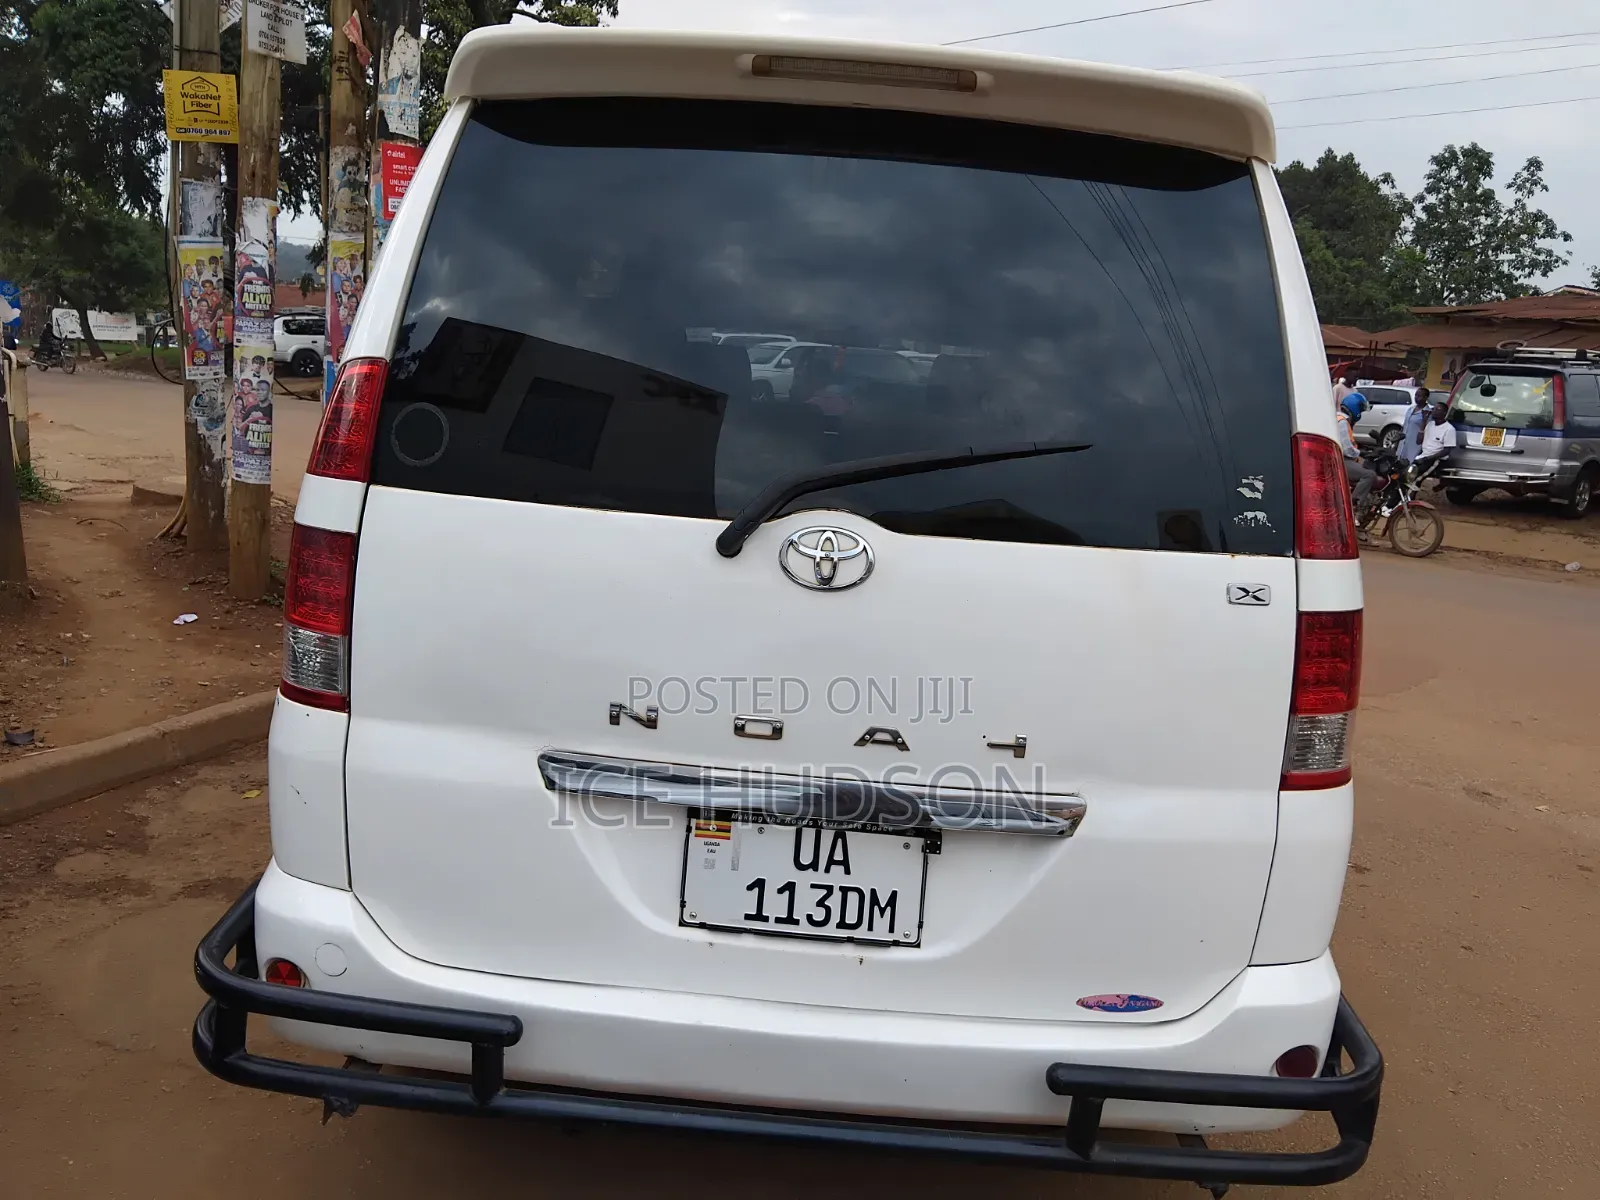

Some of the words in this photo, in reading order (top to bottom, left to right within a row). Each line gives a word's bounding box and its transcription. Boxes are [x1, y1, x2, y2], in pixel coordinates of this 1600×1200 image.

[270, 4, 280, 14] FOR
[260, 10, 273, 20] LAND
[278, 16, 292, 27] PLOT
[268, 23, 280, 34] CALL
[180, 92, 221, 100] WakaNet
[392, 150, 406, 159] airtel
[731, 812, 763, 823] Making
[785, 817, 813, 826] Roads
[866, 824, 893, 832] Space
[794, 826, 851, 875] UA
[744, 877, 898, 934] 113DM
